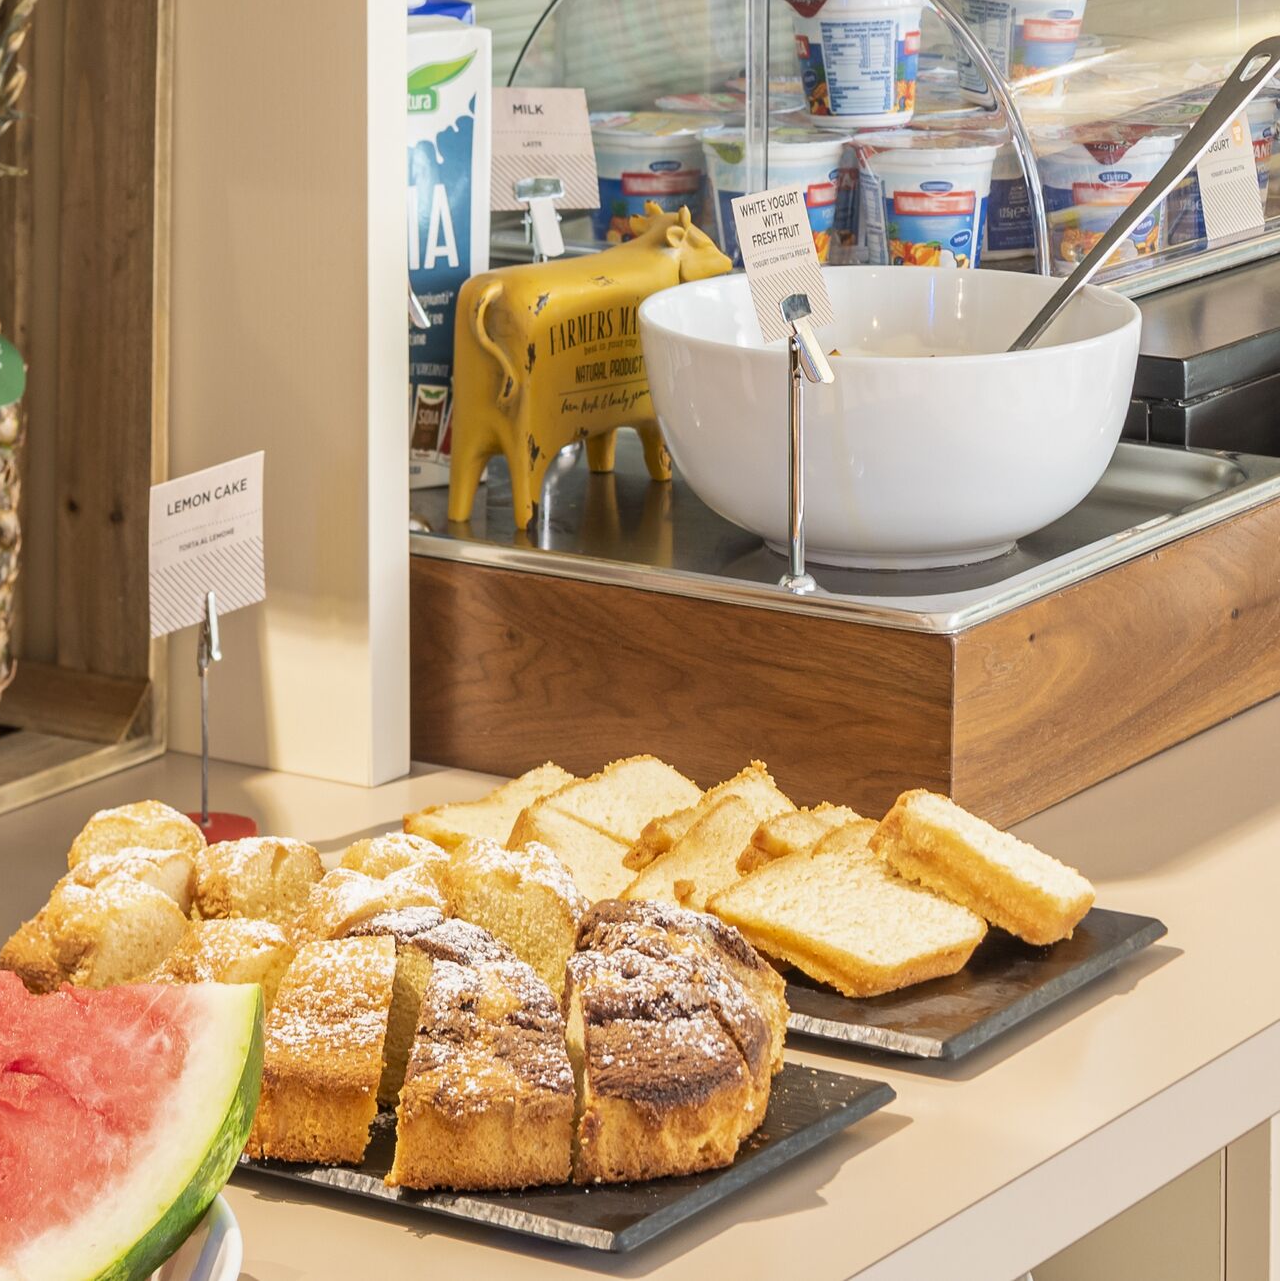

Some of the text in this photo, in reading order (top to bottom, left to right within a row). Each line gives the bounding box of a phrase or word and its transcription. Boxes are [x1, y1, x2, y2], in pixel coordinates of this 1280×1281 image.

[408, 93, 431, 110] tura
[512, 104, 544, 115] MILK
[739, 192, 799, 218] WHITE YOGURT
[762, 212, 784, 228] WITH
[752, 224, 800, 248] FRESH FRUIT
[549, 308, 613, 356] FARMERS
[575, 355, 643, 384] NATURAL PRODUCT
[167, 478, 247, 516] LEMON CAKE
